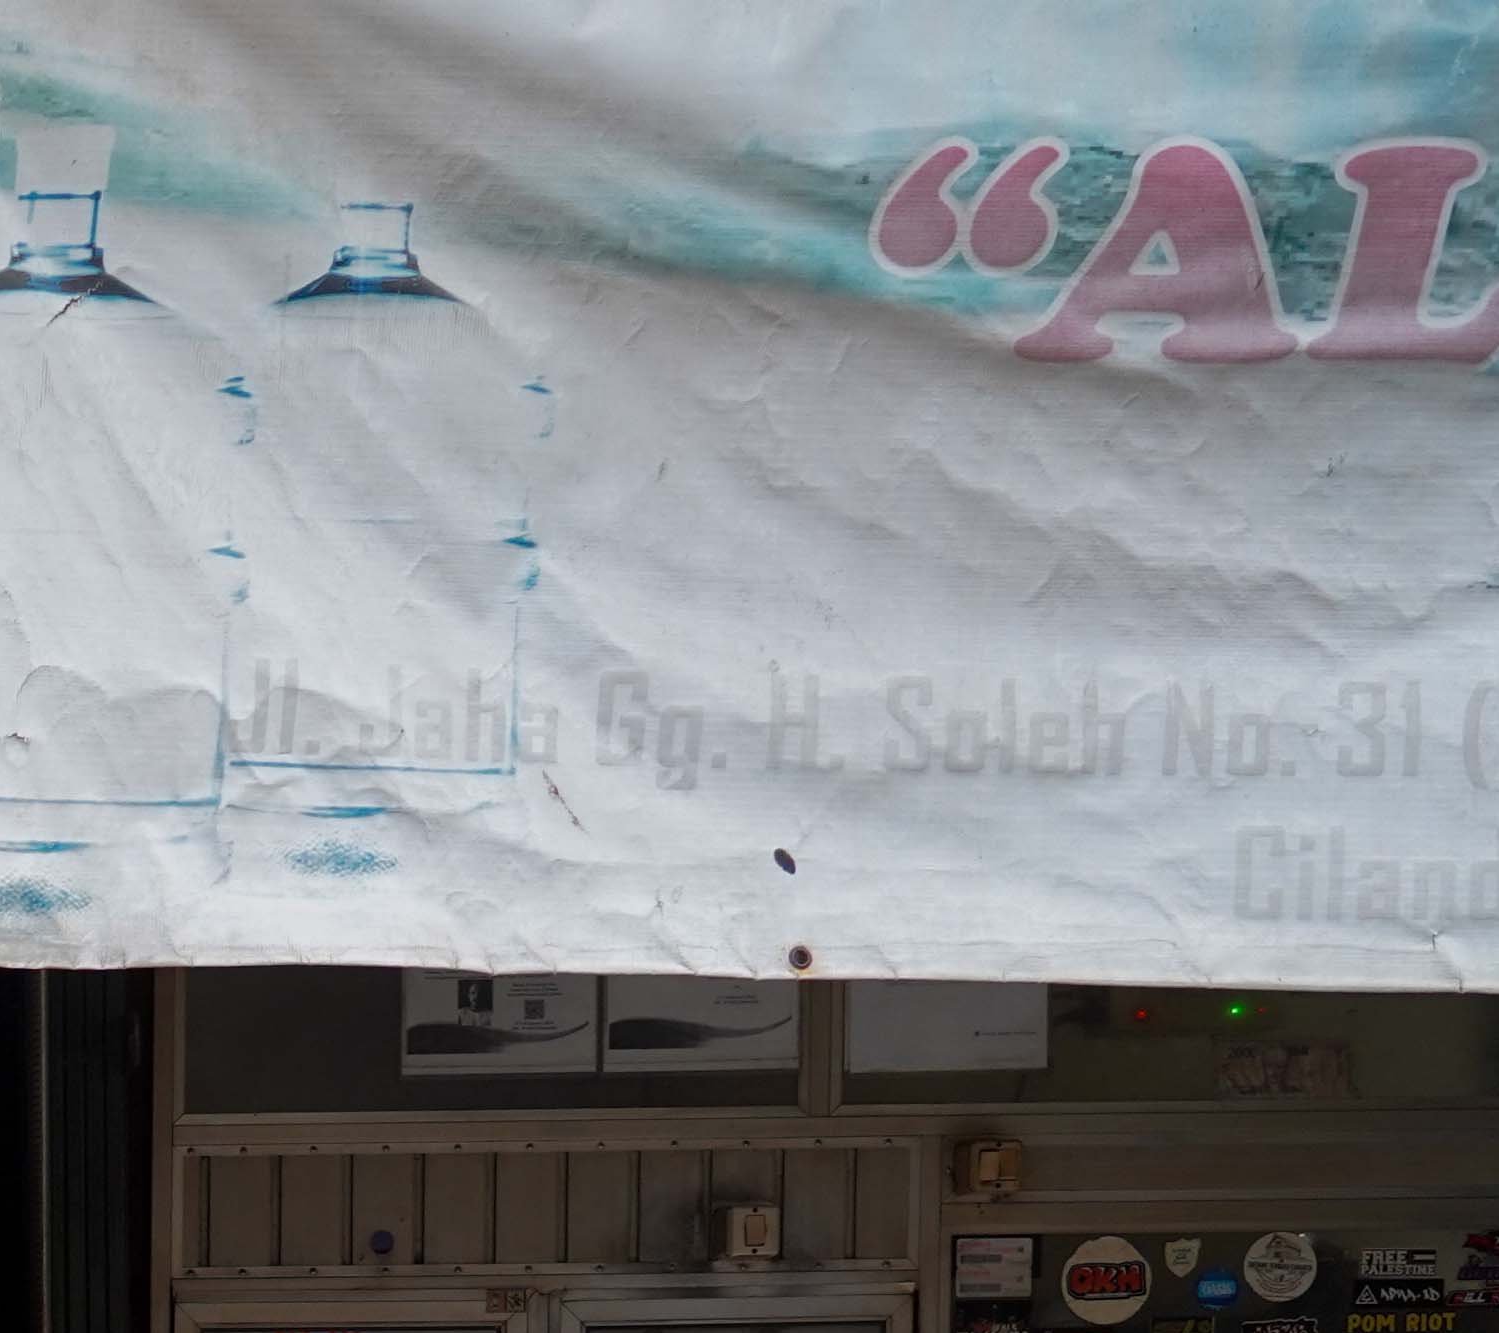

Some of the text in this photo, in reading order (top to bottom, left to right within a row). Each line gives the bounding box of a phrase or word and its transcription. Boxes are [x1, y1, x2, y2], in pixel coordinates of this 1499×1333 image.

[596, 670, 726, 791] Gg.
[883, 676, 1126, 776] Soleh
[1336, 679, 1423, 777] 31
[1361, 1250, 1408, 1265] FREE
[1360, 1264, 1437, 1276] PALESTINE
[1346, 1311, 1456, 1333] POM RIOT
